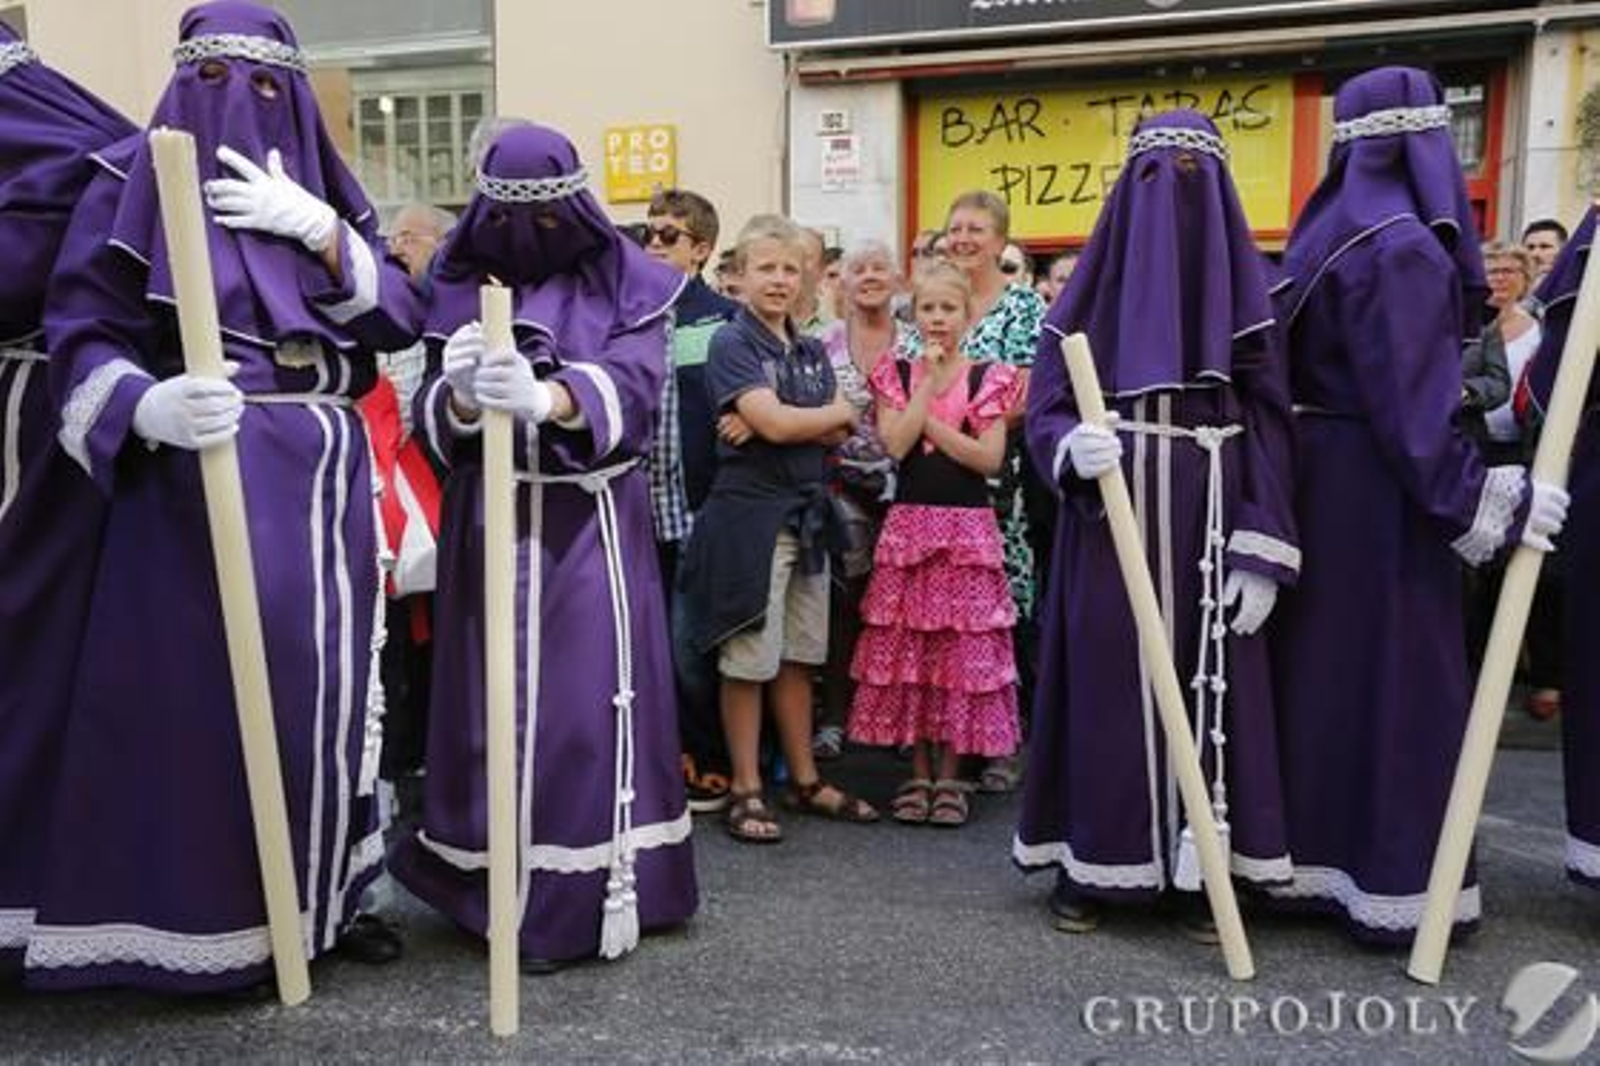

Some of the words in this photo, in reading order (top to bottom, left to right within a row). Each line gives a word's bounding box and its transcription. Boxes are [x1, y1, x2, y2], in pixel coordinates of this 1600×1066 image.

[941, 98, 1046, 148] BAR
[608, 130, 669, 153] PRO
[609, 152, 669, 175] TEO
